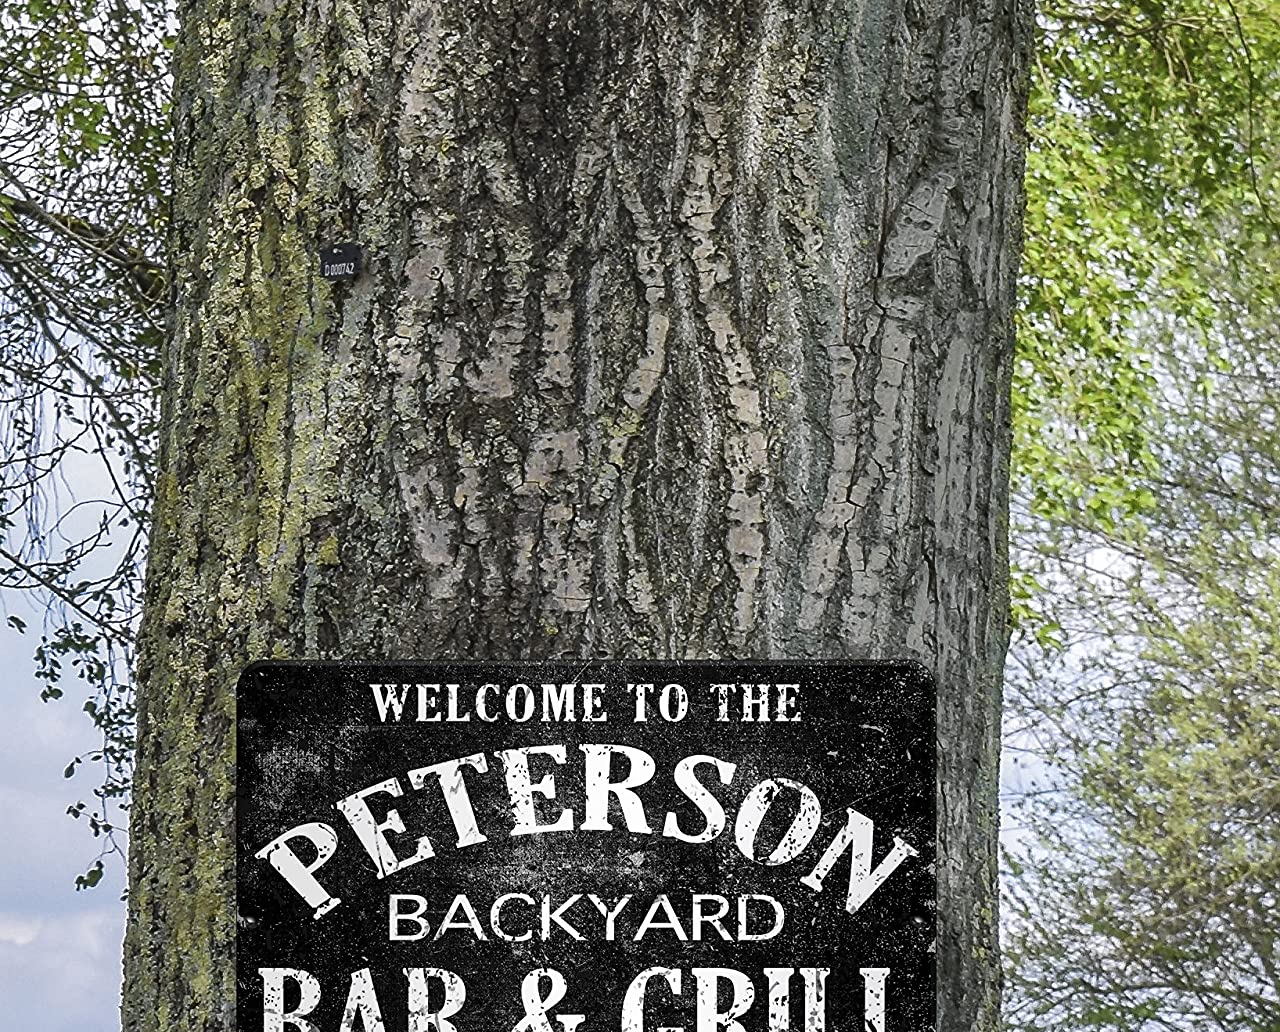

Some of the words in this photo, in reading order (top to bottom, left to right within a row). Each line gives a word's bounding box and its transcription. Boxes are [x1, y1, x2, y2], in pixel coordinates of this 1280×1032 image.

[370, 683, 607, 722] WELCOME
[627, 683, 689, 722] TO
[710, 683, 801, 722] THE
[255, 744, 919, 919] PETERSON
[389, 891, 785, 942] BACKYARD
